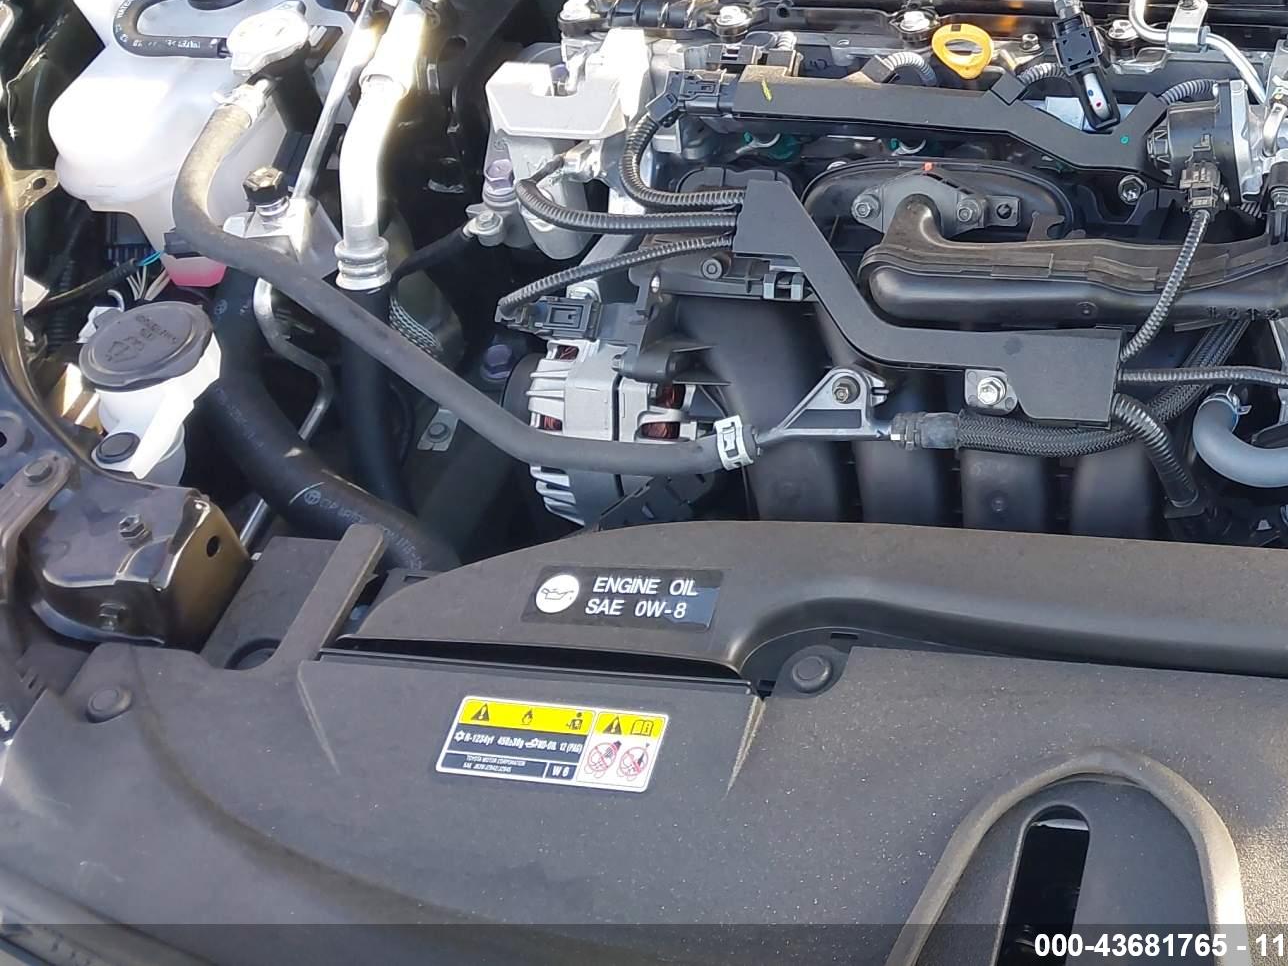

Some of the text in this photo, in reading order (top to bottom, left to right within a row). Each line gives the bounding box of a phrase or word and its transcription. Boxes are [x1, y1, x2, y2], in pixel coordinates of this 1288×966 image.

[592, 576, 699, 596] ENGINE OIL
[585, 598, 688, 619] SAE 0W-8
[552, 765, 562, 776] W
